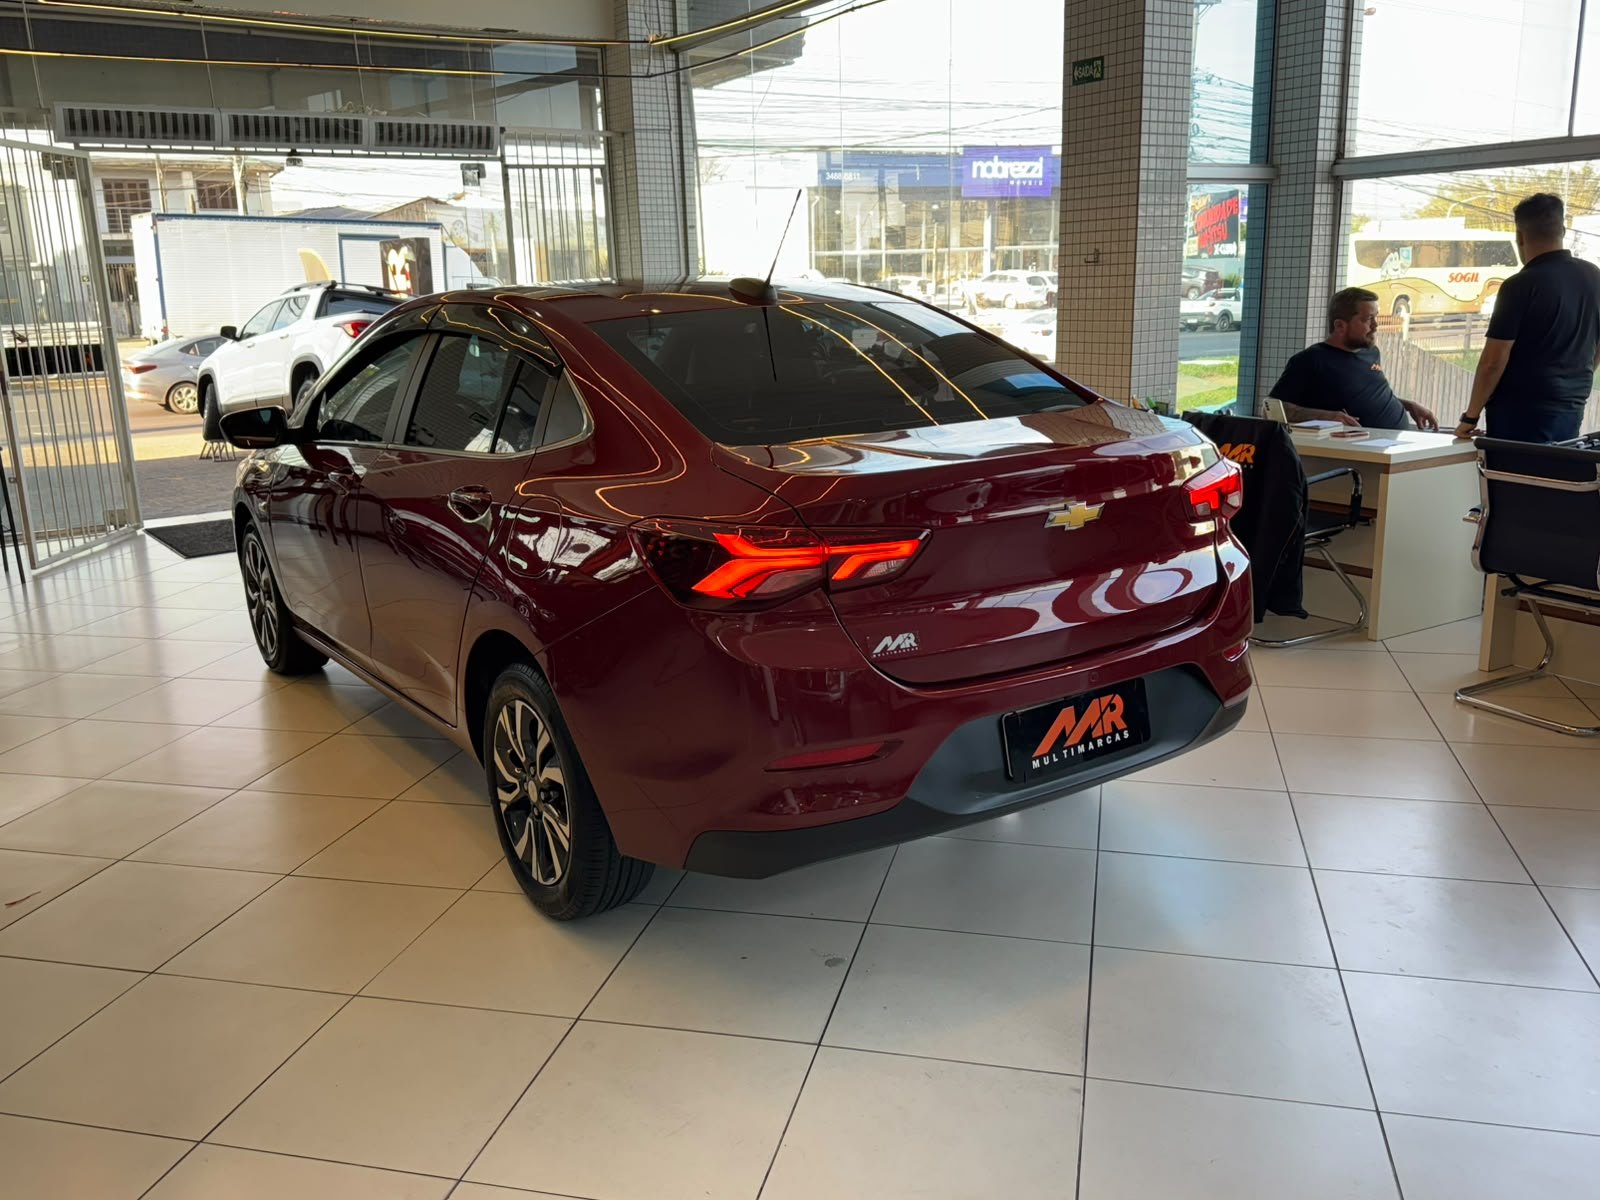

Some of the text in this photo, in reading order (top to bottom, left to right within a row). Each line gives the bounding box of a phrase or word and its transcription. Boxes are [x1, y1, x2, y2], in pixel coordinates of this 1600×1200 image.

[972, 155, 1043, 179] nobrezzi
[1448, 272, 1479, 283] SOGIL
[1032, 730, 1130, 770] MULTIMARCAS
